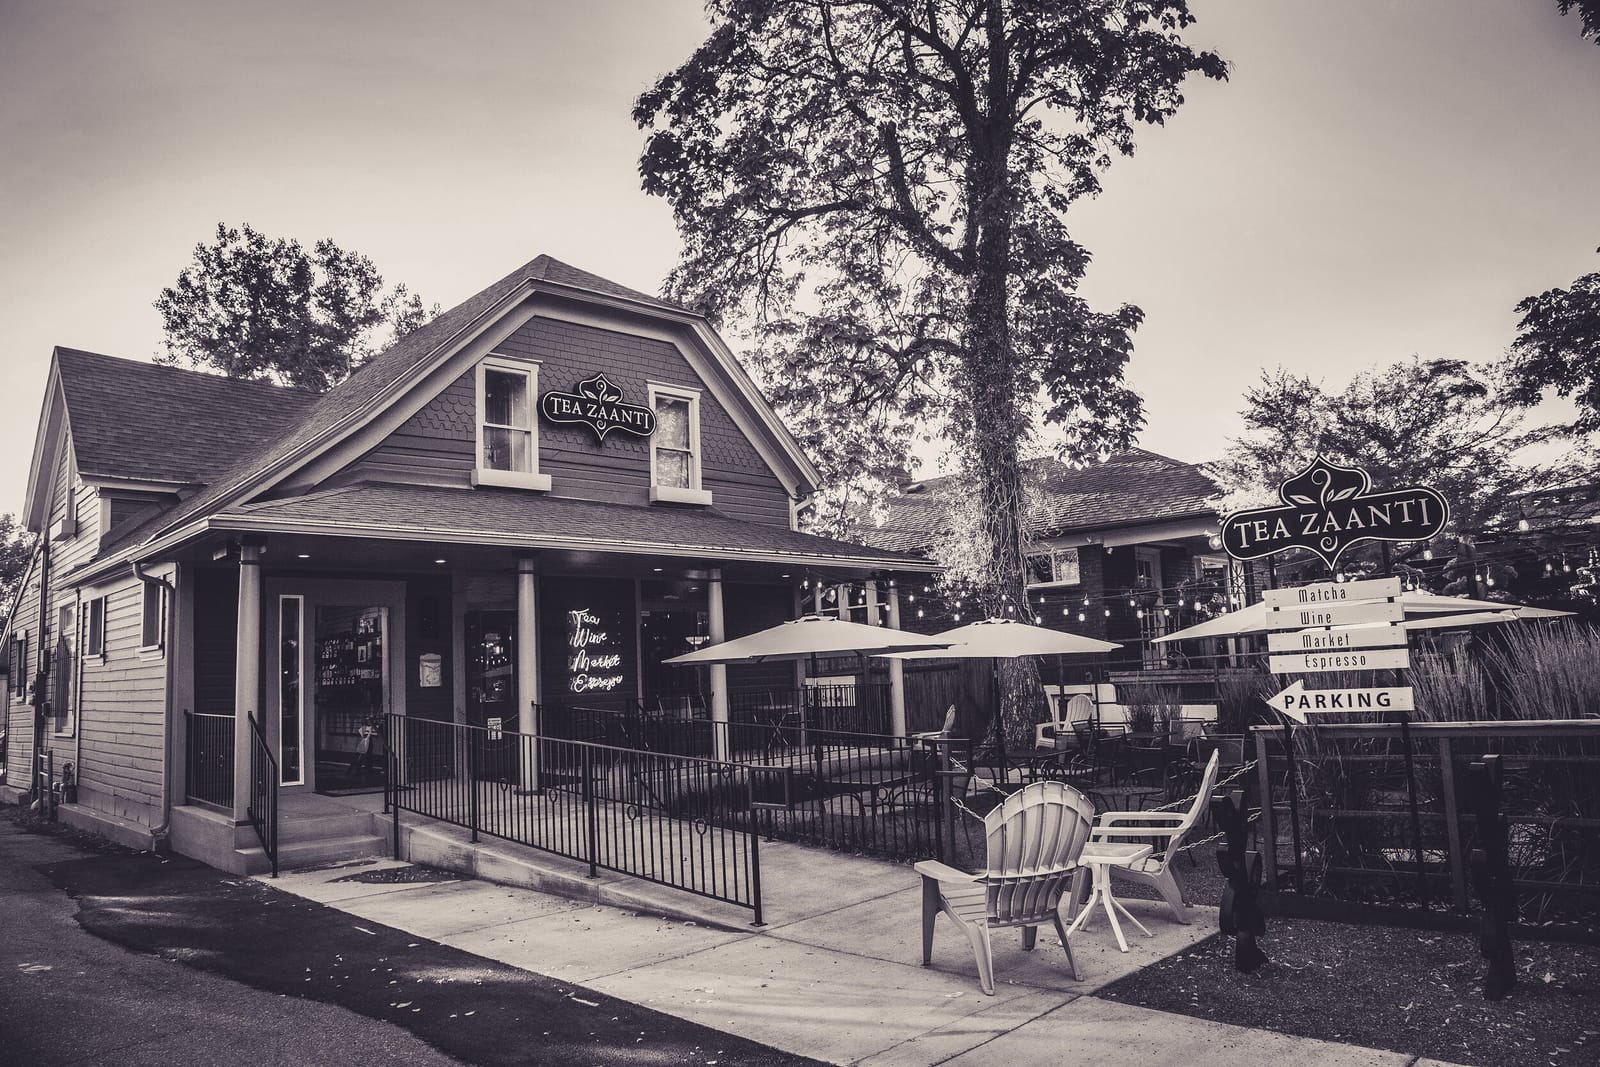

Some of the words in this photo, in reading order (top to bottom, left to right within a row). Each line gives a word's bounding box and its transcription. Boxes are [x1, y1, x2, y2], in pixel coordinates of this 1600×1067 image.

[550, 397, 583, 415] TEA
[587, 403, 650, 429] ZAANTI
[1233, 518, 1292, 549] TEA
[1300, 498, 1432, 536] ZAANTI
[1299, 586, 1346, 603] Matcha
[569, 608, 601, 629] Tea
[1300, 611, 1332, 625] Wine
[573, 628, 608, 648] Wine
[1302, 632, 1349, 648] Market
[1305, 654, 1367, 670] Espresso
[1284, 691, 1392, 709] PARKING
